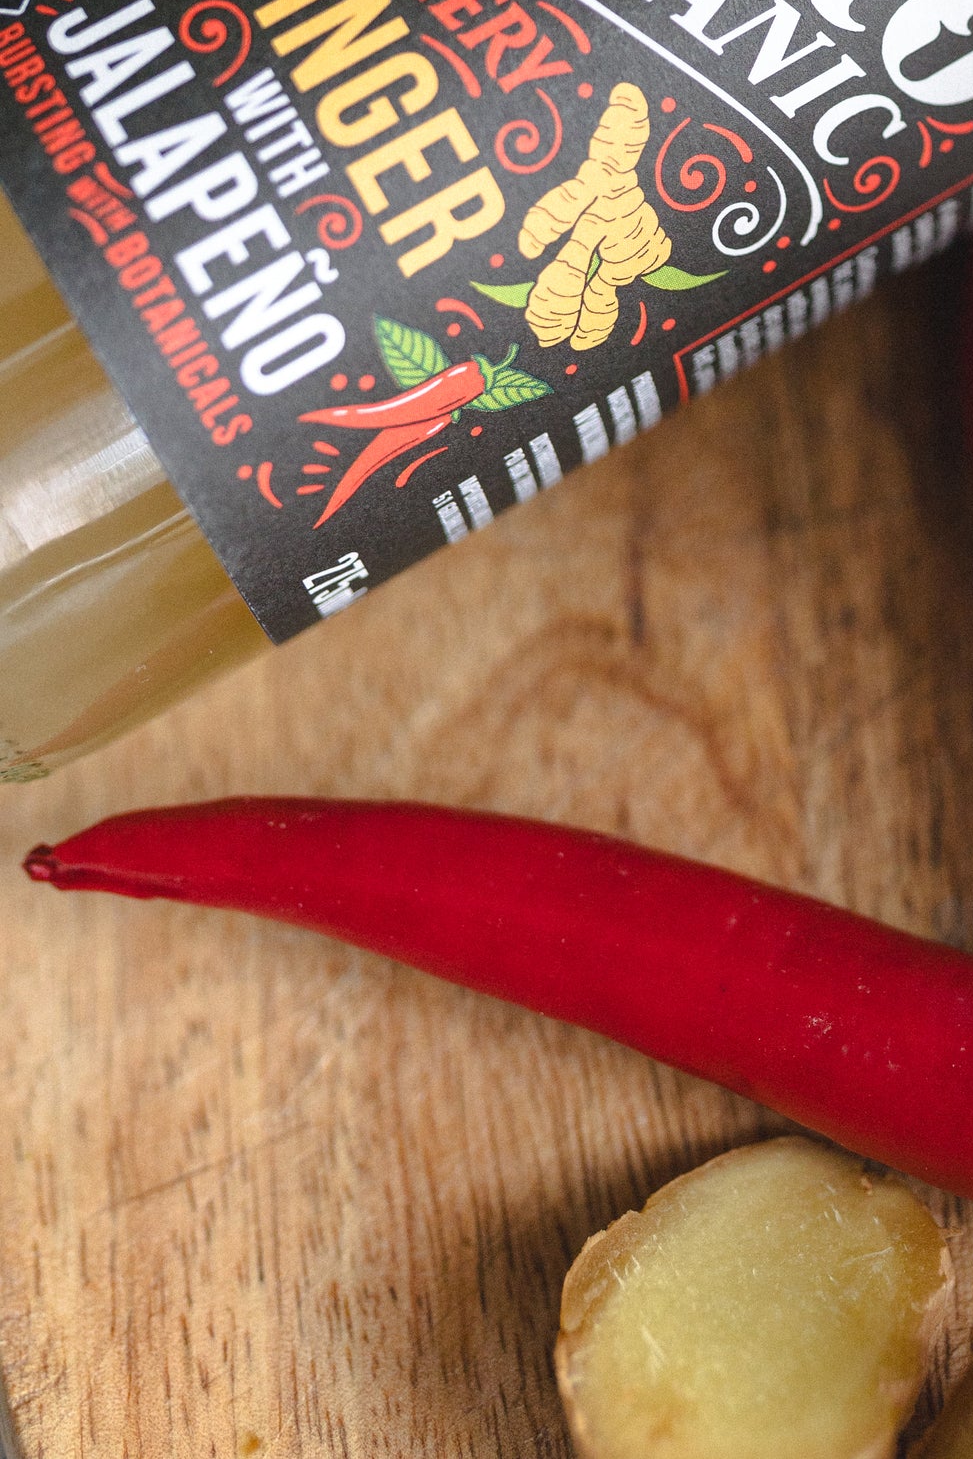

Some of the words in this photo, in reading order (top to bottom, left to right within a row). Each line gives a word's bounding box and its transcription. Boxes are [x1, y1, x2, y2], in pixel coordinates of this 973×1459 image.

[223, 67, 330, 199] WITH
[0, 21, 97, 175] BURSTING
[65, 174, 139, 233] WITH
[104, 230, 254, 447] BOTANICALS
[431, 490, 454, 509] 51
